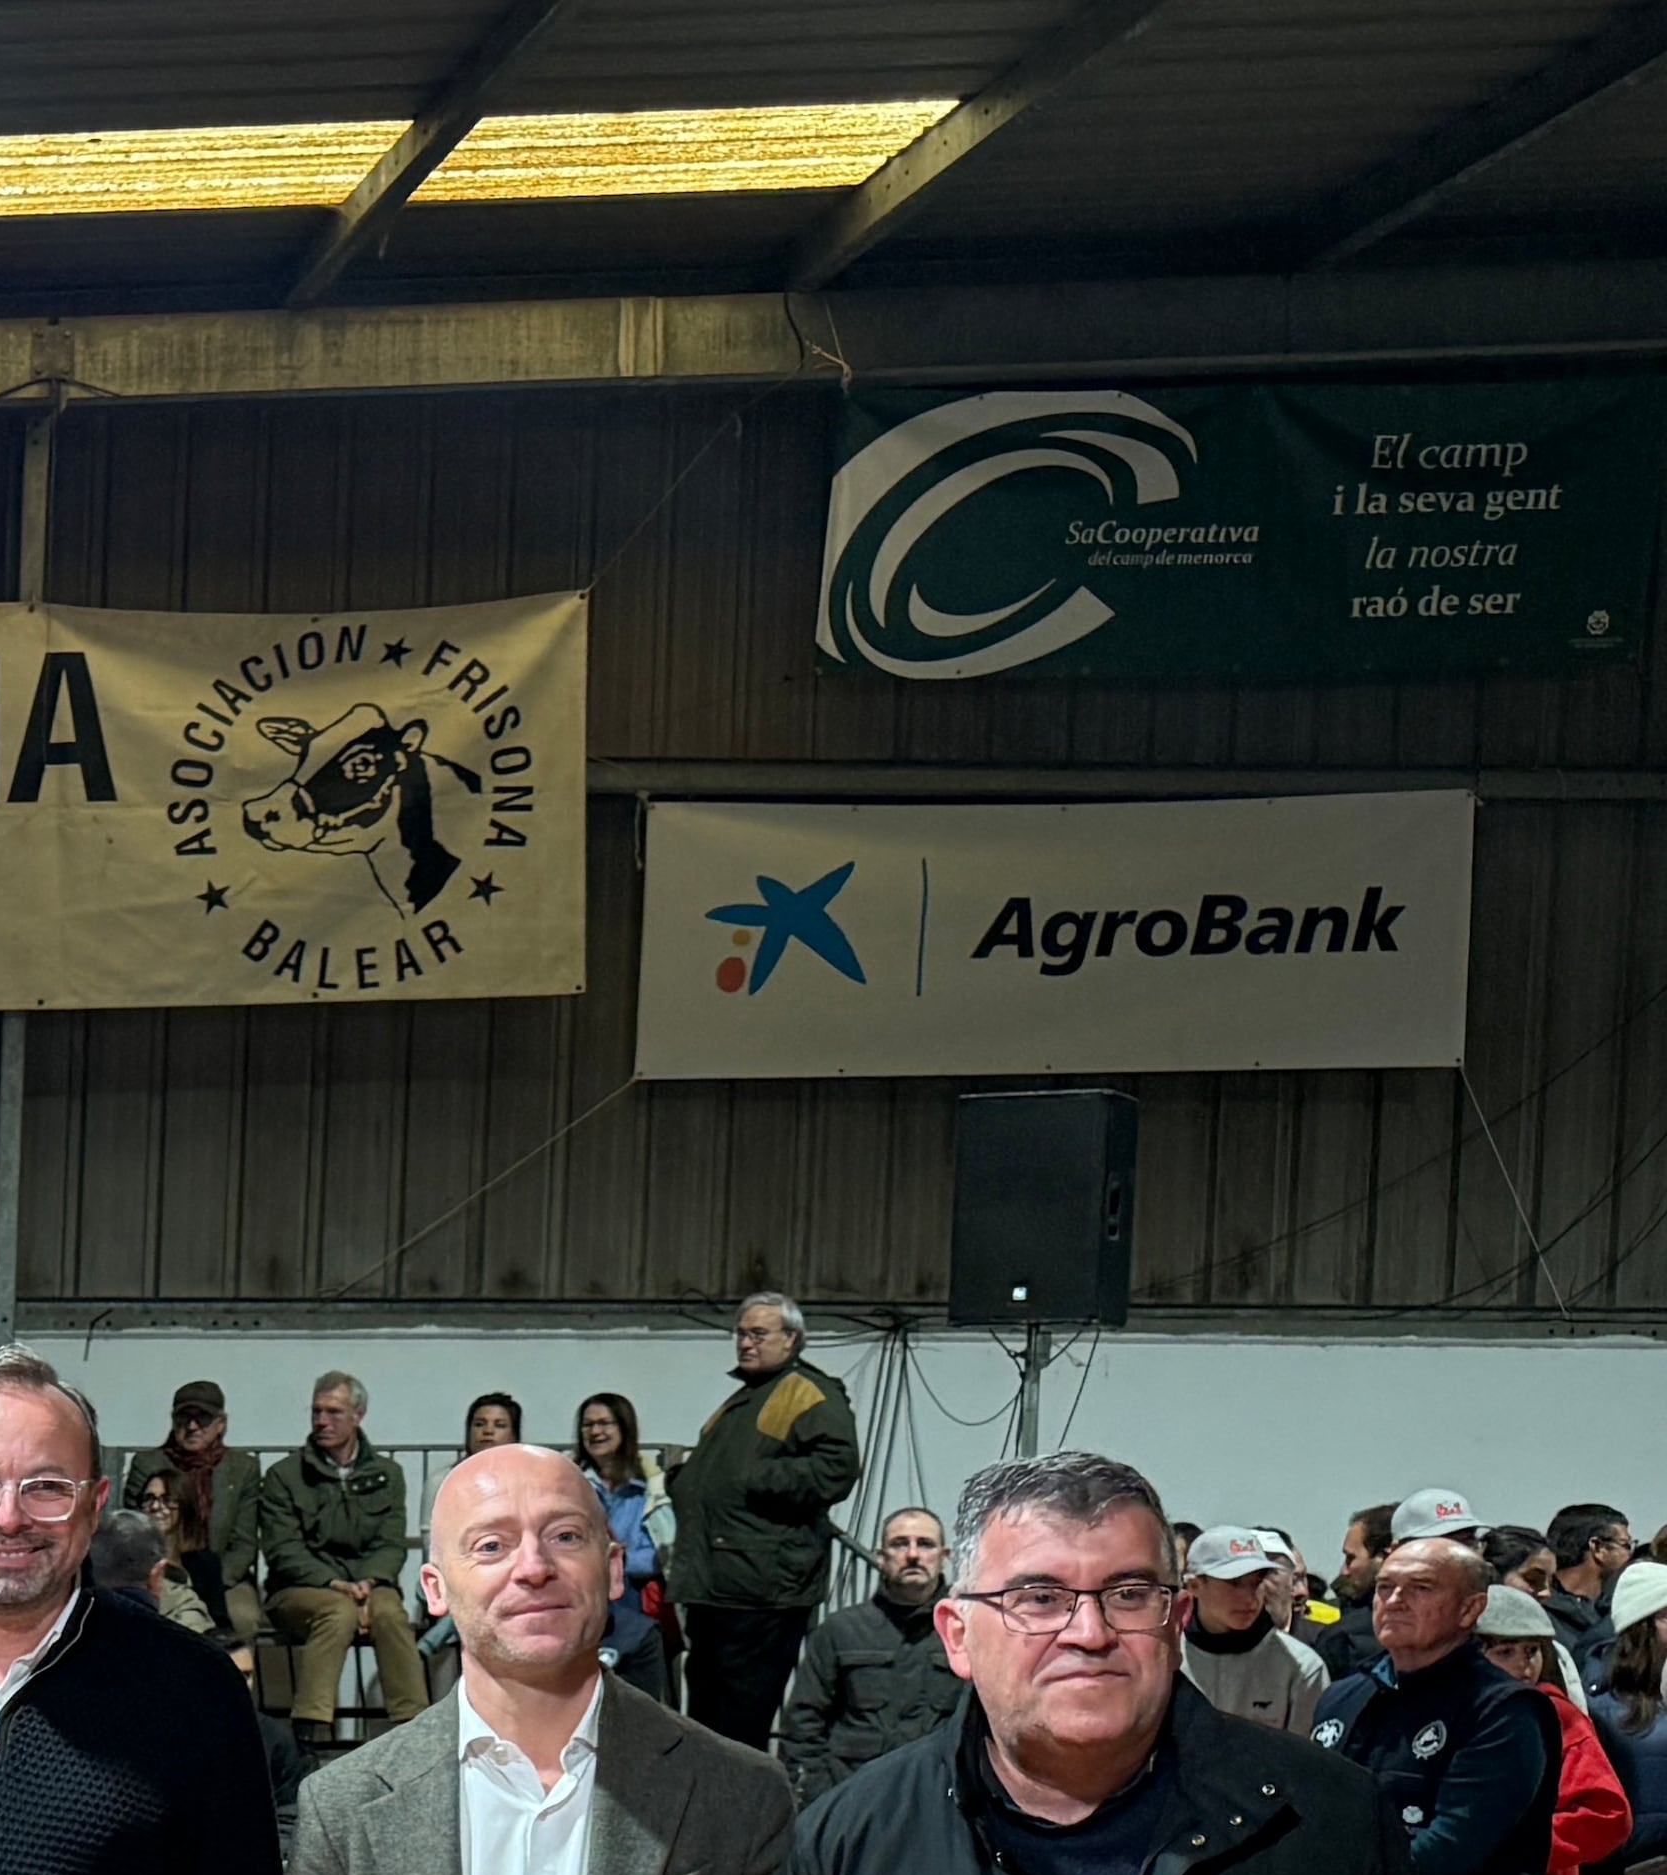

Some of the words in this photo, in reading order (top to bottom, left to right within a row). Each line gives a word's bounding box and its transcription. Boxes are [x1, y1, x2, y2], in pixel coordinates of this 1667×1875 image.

[1371, 433, 1412, 469] El
[1419, 442, 1528, 477] camp
[1332, 485, 1344, 516] i
[1354, 482, 1388, 515] la
[1398, 491, 1475, 514] seva
[1483, 484, 1563, 521] gent
[1177, 552, 1253, 565] menorca
[1365, 536, 1397, 569] la
[1408, 540, 1518, 568] nostra
[1350, 587, 1408, 618] raó
[1418, 585, 1460, 617] de
[1468, 592, 1521, 615] ser
[167, 624, 367, 857] ASOCIACION
[421, 640, 534, 849] FRISONA
[969, 885, 1406, 976] AgroBank
[241, 918, 465, 990] BALEAR
